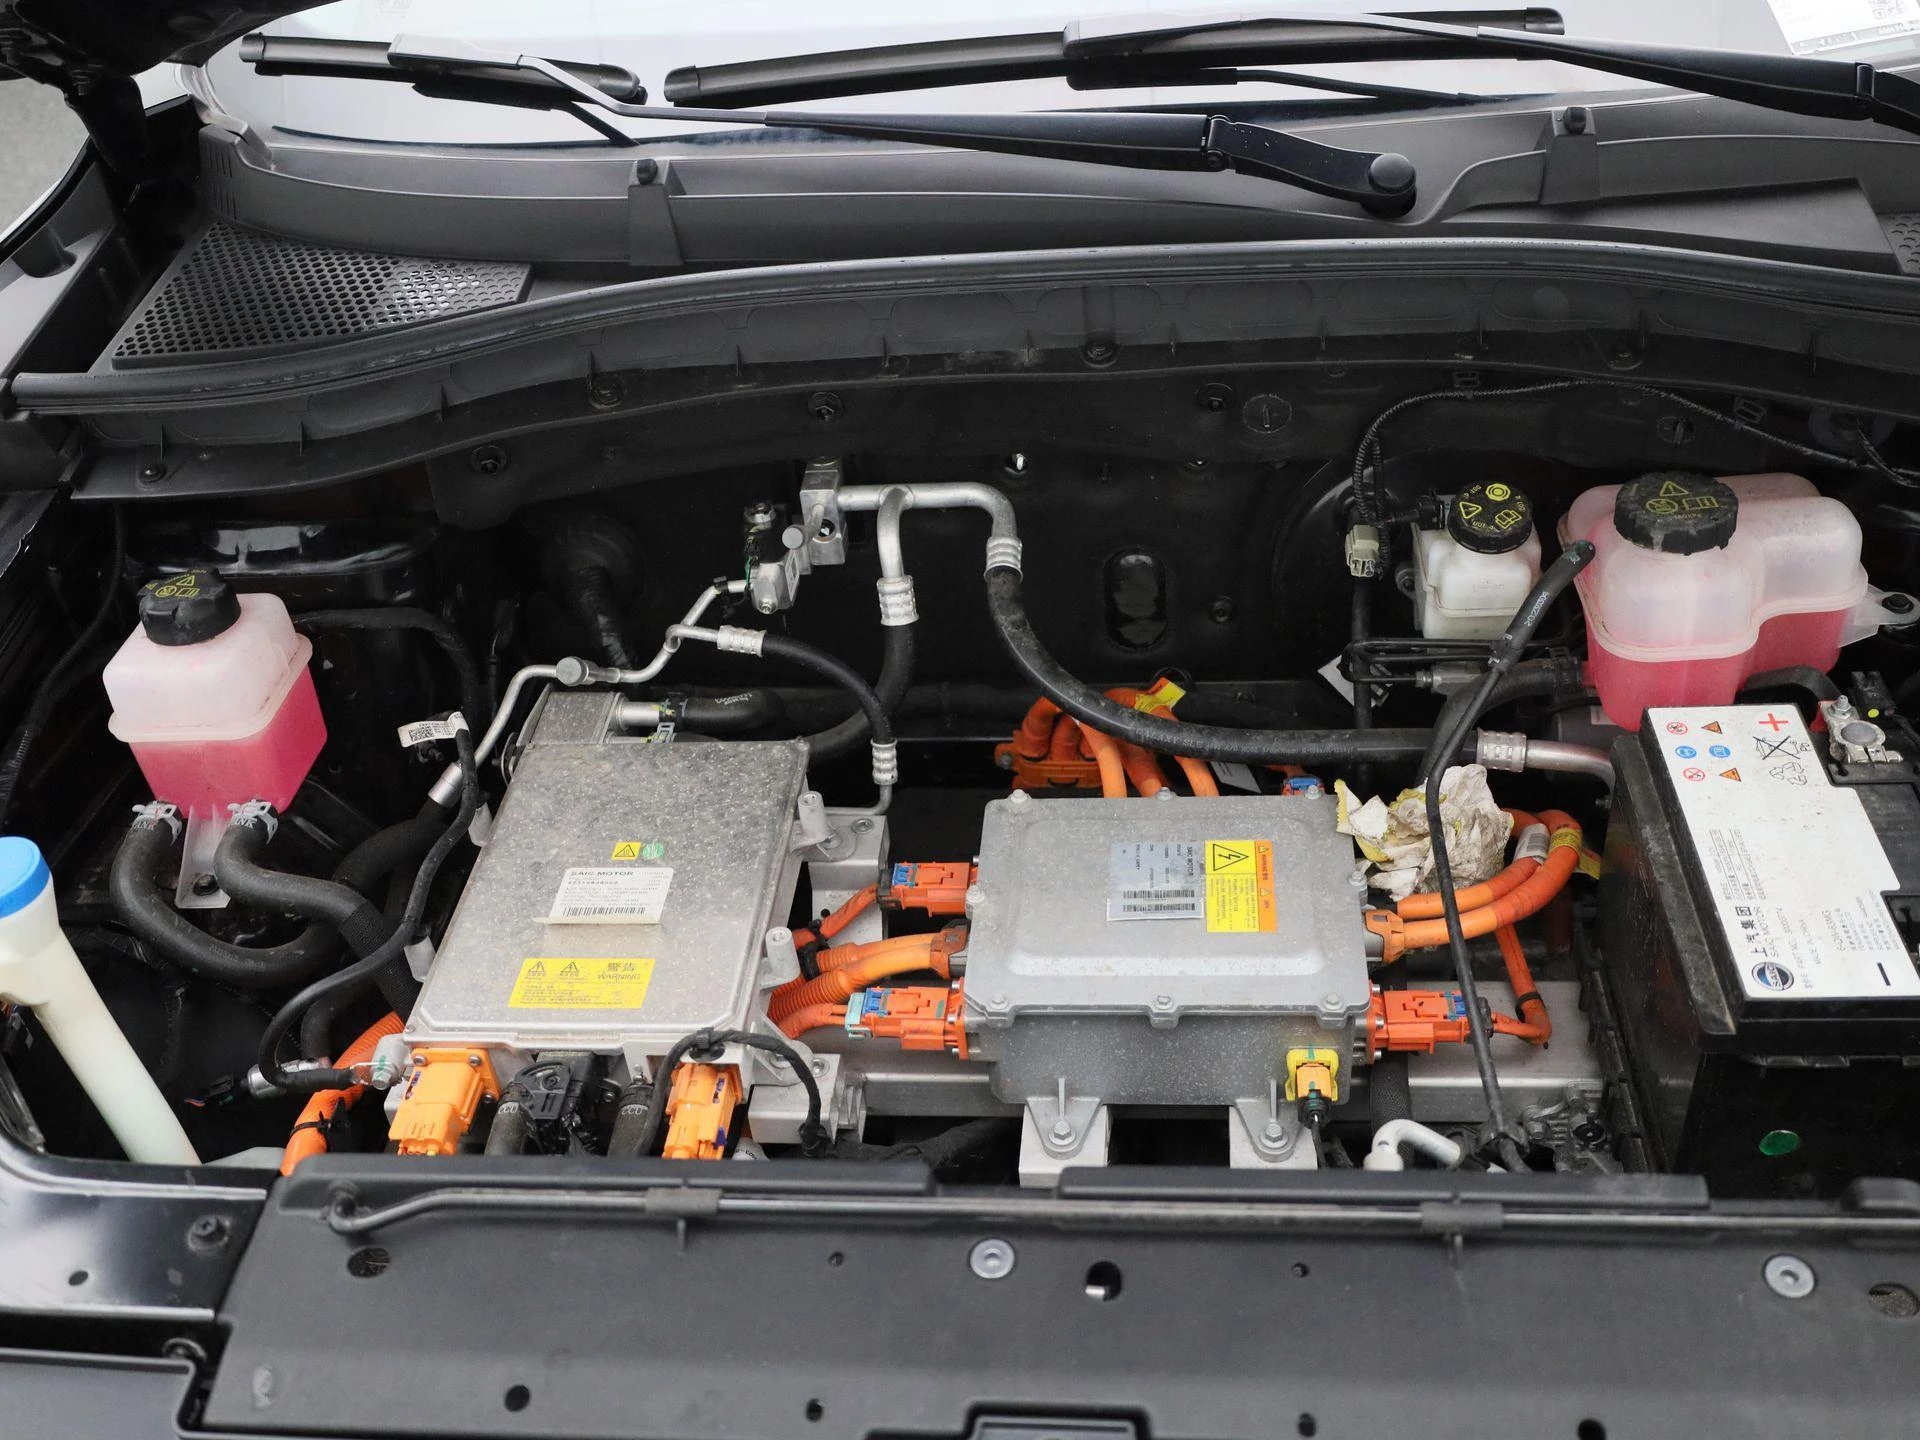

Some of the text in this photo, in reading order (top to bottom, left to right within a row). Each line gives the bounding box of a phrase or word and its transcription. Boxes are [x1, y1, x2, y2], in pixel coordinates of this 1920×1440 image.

[1733, 905, 1767, 957] 上汽集团
[1752, 905, 1779, 957] SAIC MOTOR
[597, 973, 641, 981] WARNING
[1765, 963, 1782, 987] SAIC
